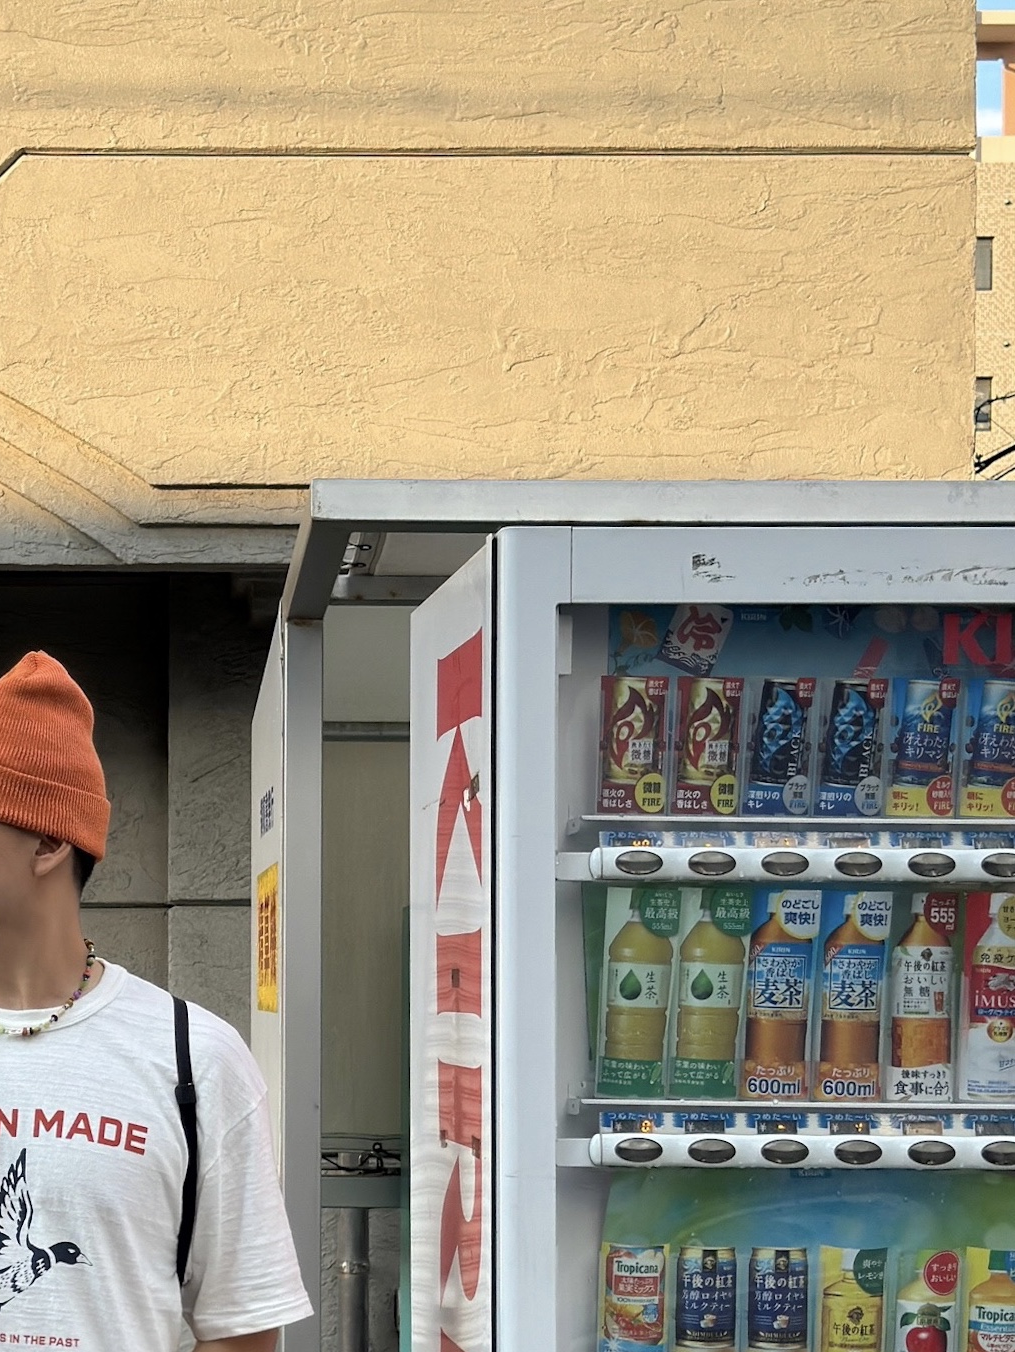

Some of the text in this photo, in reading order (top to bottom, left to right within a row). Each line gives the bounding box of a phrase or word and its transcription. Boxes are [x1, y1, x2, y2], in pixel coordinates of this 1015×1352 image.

[917, 724, 940, 734] FIRE
[787, 730, 801, 776] BLACK
[859, 731, 873, 778] BLACK
[677, 789, 701, 799] 直火の
[642, 797, 661, 806] FIRE
[717, 799, 734, 808] FIRE
[782, 898, 819, 910] のどごし
[858, 900, 892, 912] のどごし
[645, 907, 679, 920] 最高級
[715, 907, 750, 920] 最高級
[930, 907, 956, 923] 555
[761, 957, 800, 968] さわやか
[837, 958, 875, 969] さわやか
[903, 960, 946, 973] 午後の紅茶
[765, 968, 796, 979] 香ばし
[842, 969, 872, 980] 香ばし
[645, 971, 658, 1000] 生茶
[716, 971, 730, 1000] 生茶
[903, 975, 947, 986] おいしい
[756, 977, 803, 1006] 麦茶
[831, 979, 878, 1008] 麦茶
[903, 986, 930, 998] 無糖
[755, 1065, 796, 1076] たっぷり
[832, 1067, 872, 1078] たっぷり
[901, 1069, 946, 1080] 後味すっきり
[747, 1077, 801, 1095] 600ml
[822, 1079, 875, 1097] 600ml
[893, 1080, 950, 1097] 食事に合う
[33, 1108, 148, 1156] MADE
[615, 1260, 659, 1275] Tropicana
[682, 1274, 734, 1288] 午後の紅茶
[754, 1275, 806, 1290] 午後の紅茶
[618, 1283, 655, 1294] 果実ミックス
[684, 1301, 731, 1312] ミルクティー
[756, 1302, 803, 1313] ミルクティー
[833, 1322, 876, 1336] 午後の紅茶
[9, 1333, 20, 1344] IN
[23, 1334, 47, 1345] THE
[48, 1336, 80, 1348] PAST
